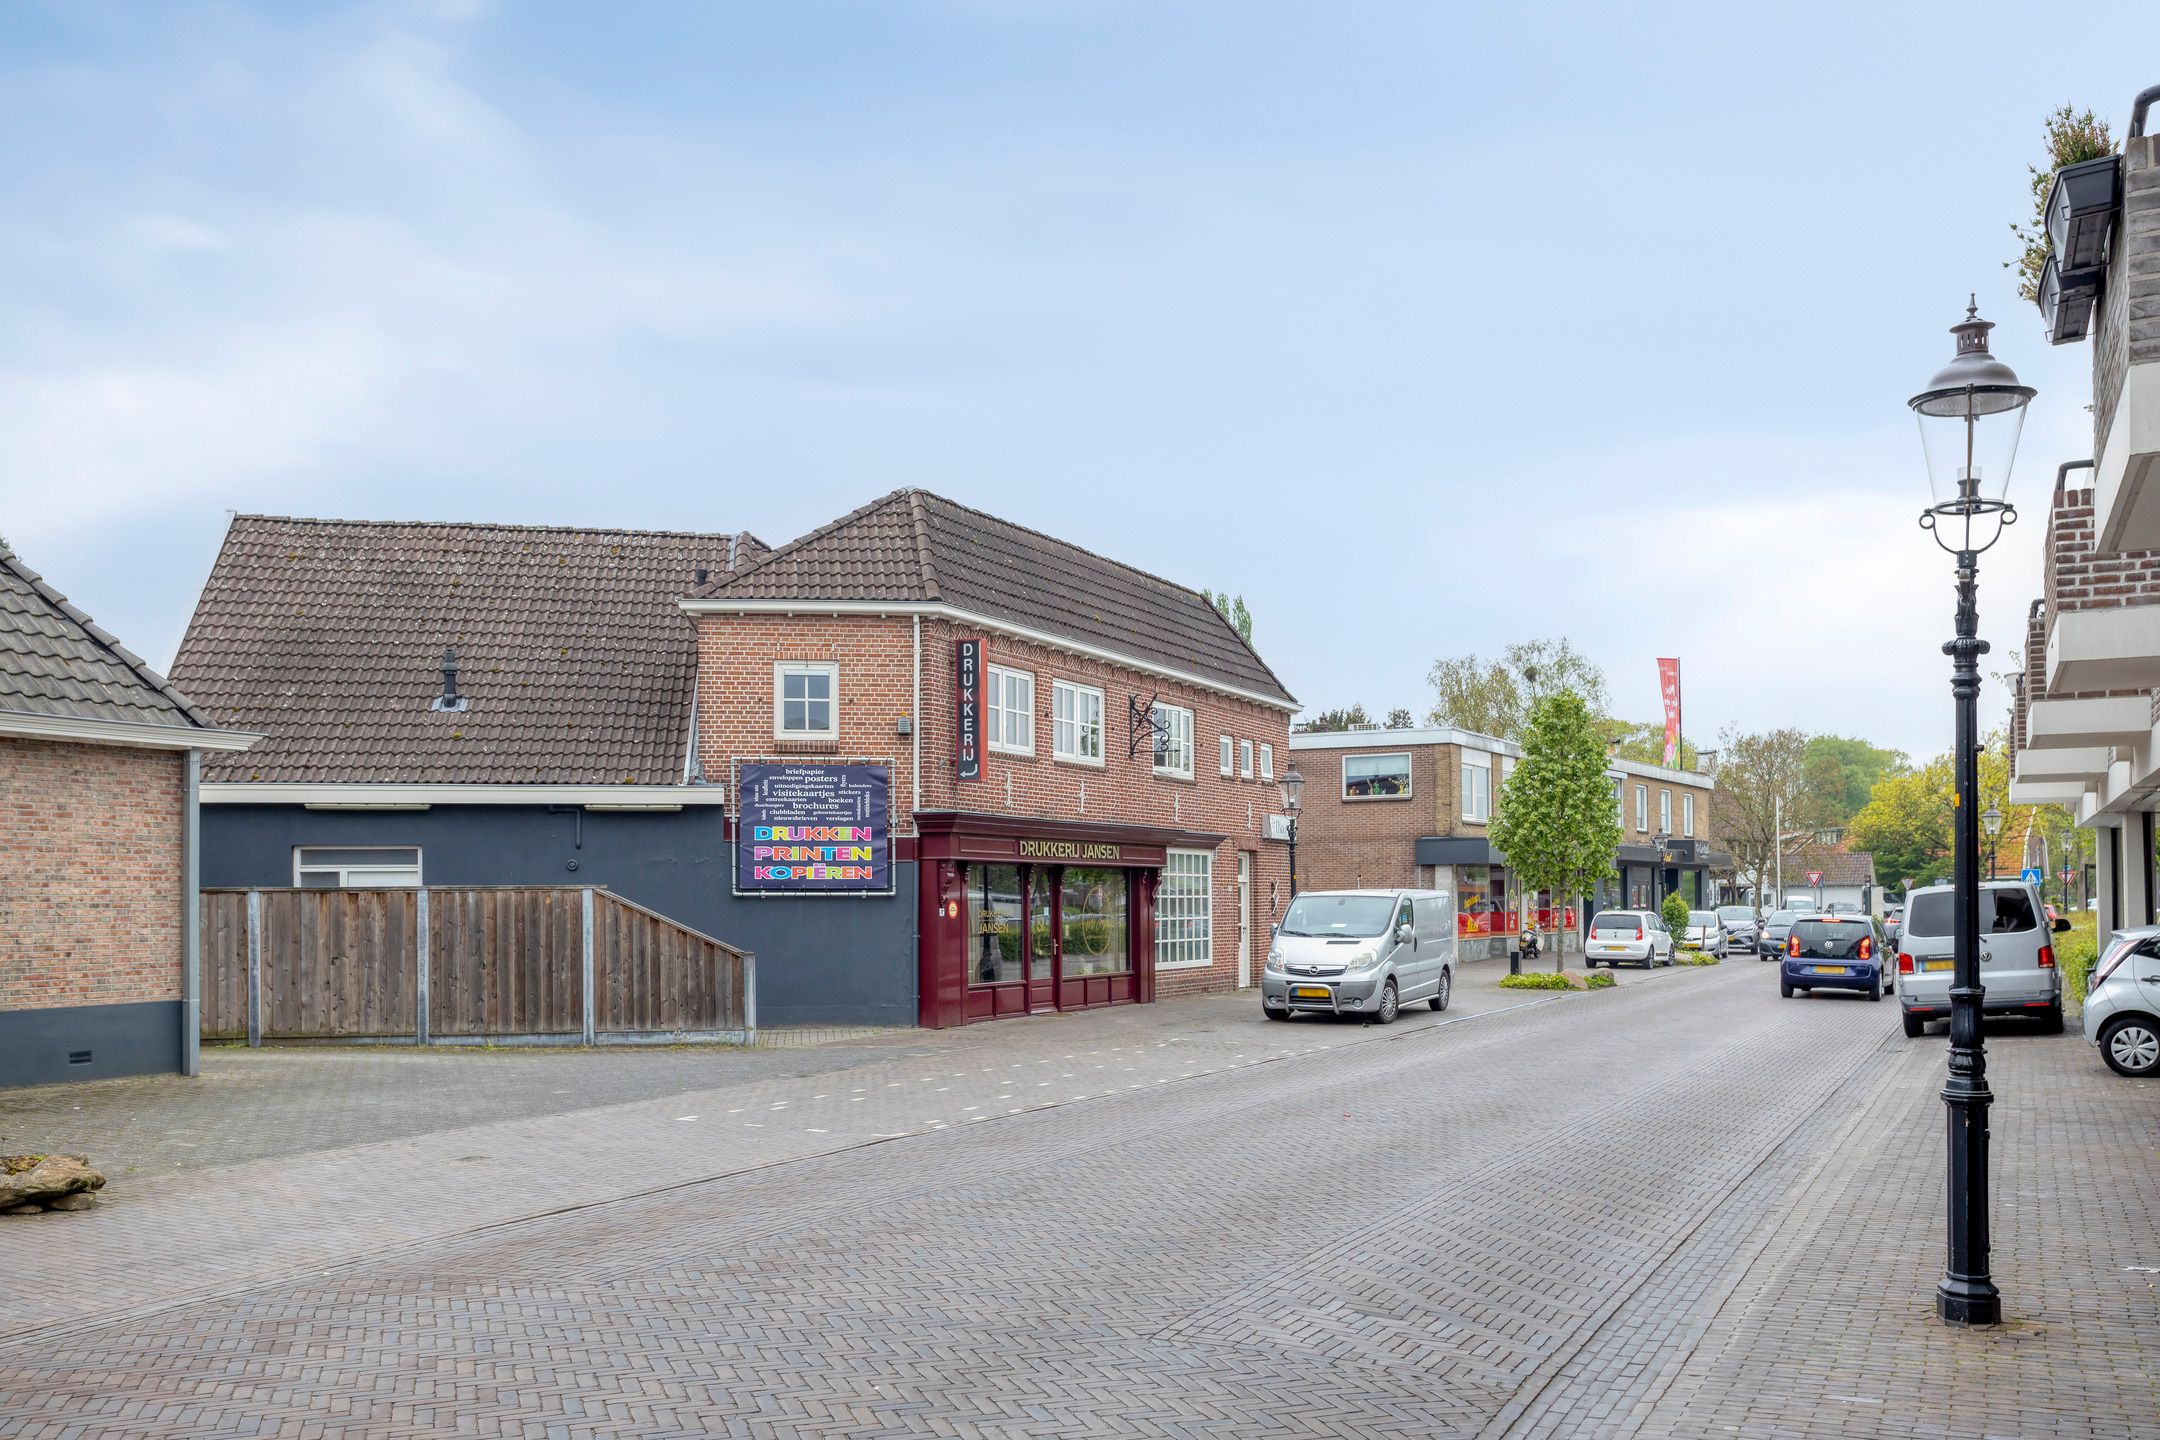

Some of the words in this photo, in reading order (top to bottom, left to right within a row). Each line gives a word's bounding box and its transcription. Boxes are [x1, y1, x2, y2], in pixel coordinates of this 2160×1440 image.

[962, 642, 975, 763] DRUKKERIJ
[804, 775, 838, 783] posters
[772, 789, 835, 798] visitekaartjes
[792, 801, 839, 810] brochures
[754, 826, 872, 841] DRUKKEN
[754, 846, 872, 861] PRINTEN
[1019, 840, 1080, 858] DRUKKERIJ
[1082, 844, 1120, 859] JANSEN
[754, 863, 873, 880] KOPIËREN
[977, 922, 1009, 935] JANSEN
